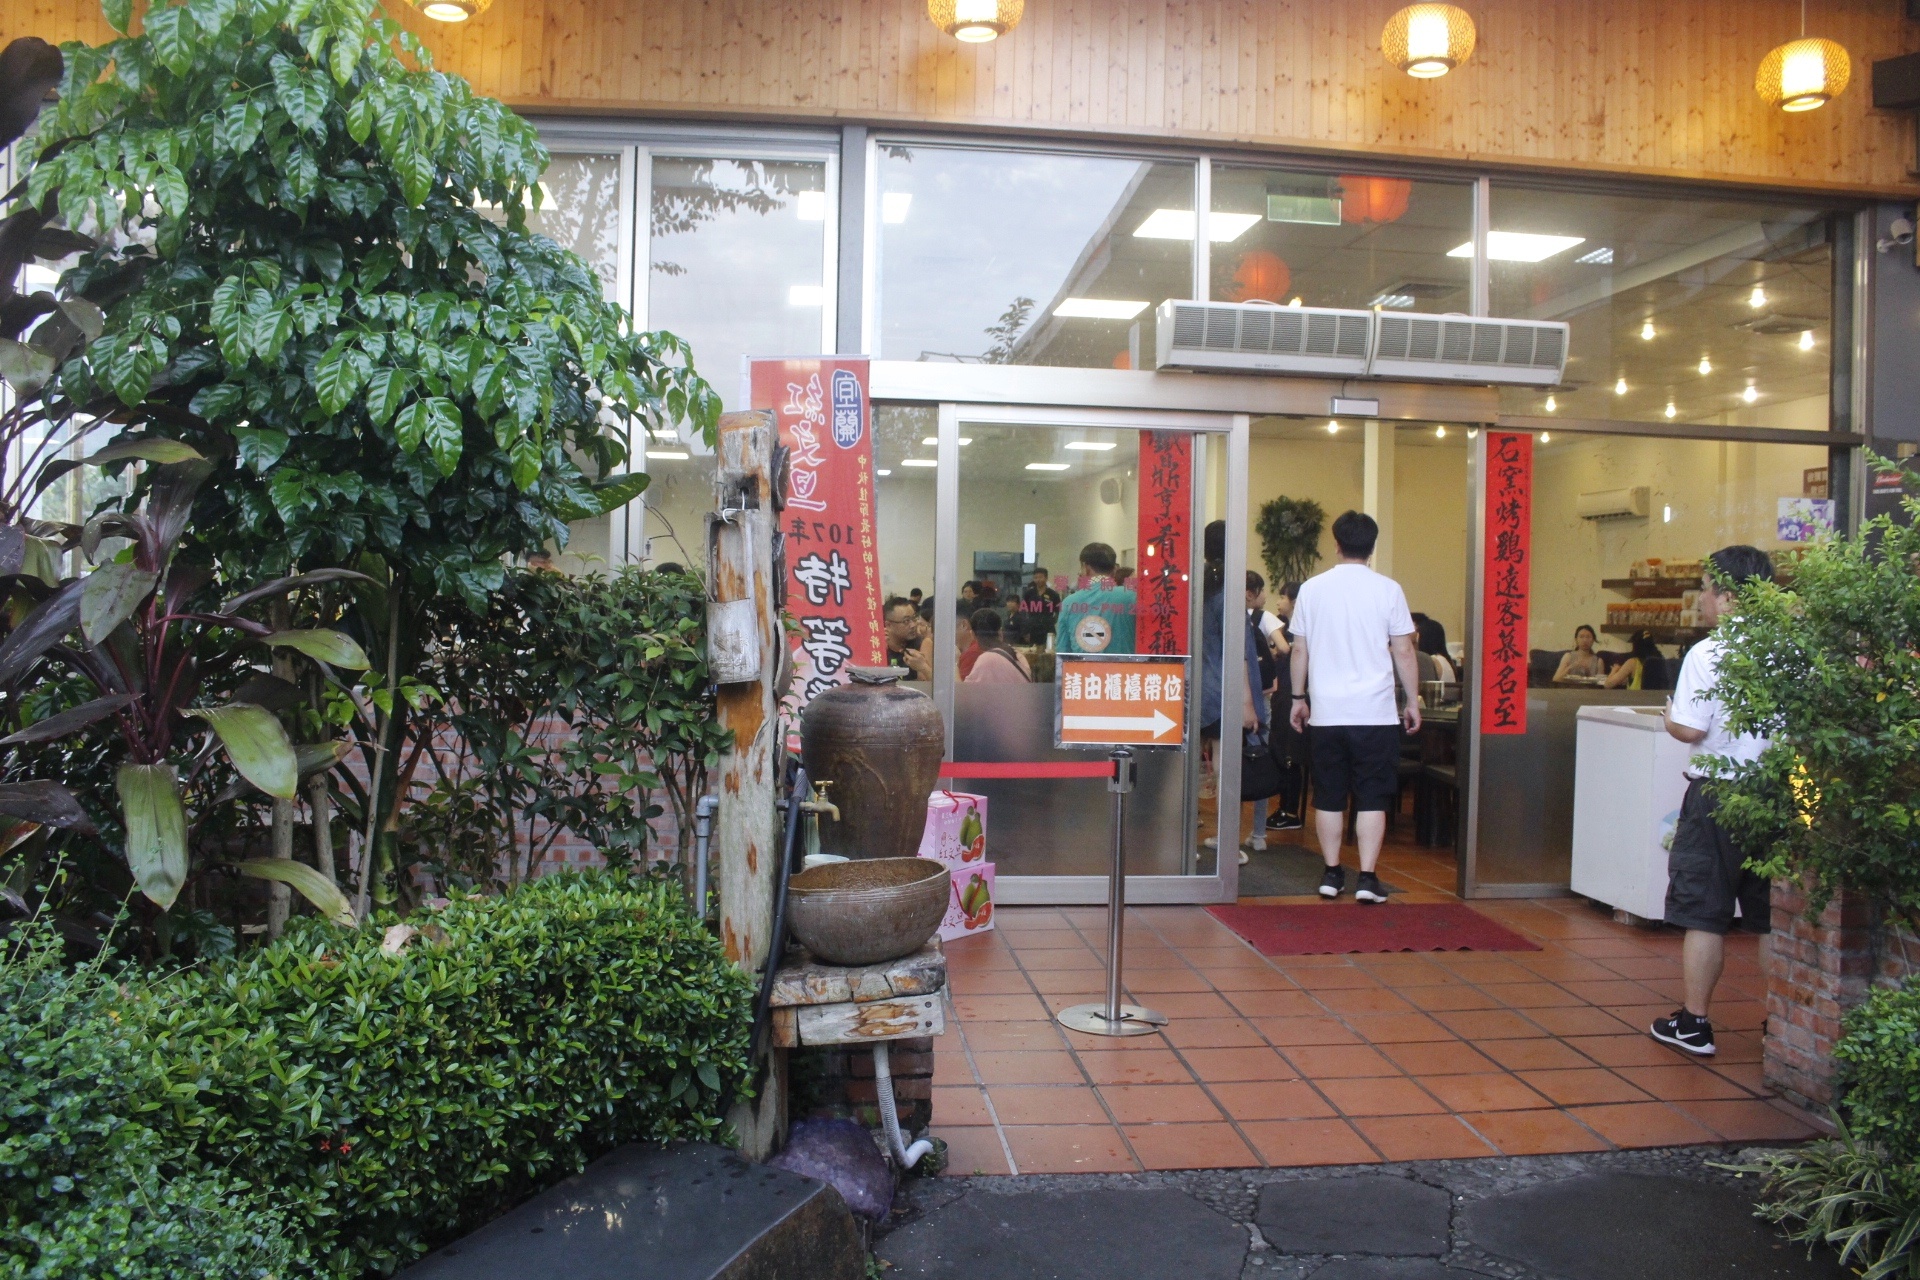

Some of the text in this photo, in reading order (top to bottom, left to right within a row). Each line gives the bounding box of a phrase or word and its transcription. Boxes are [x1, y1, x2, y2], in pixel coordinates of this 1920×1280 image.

[1018, 601, 1042, 613] AM
[1064, 672, 1182, 701] 請由櫃檯帶位
